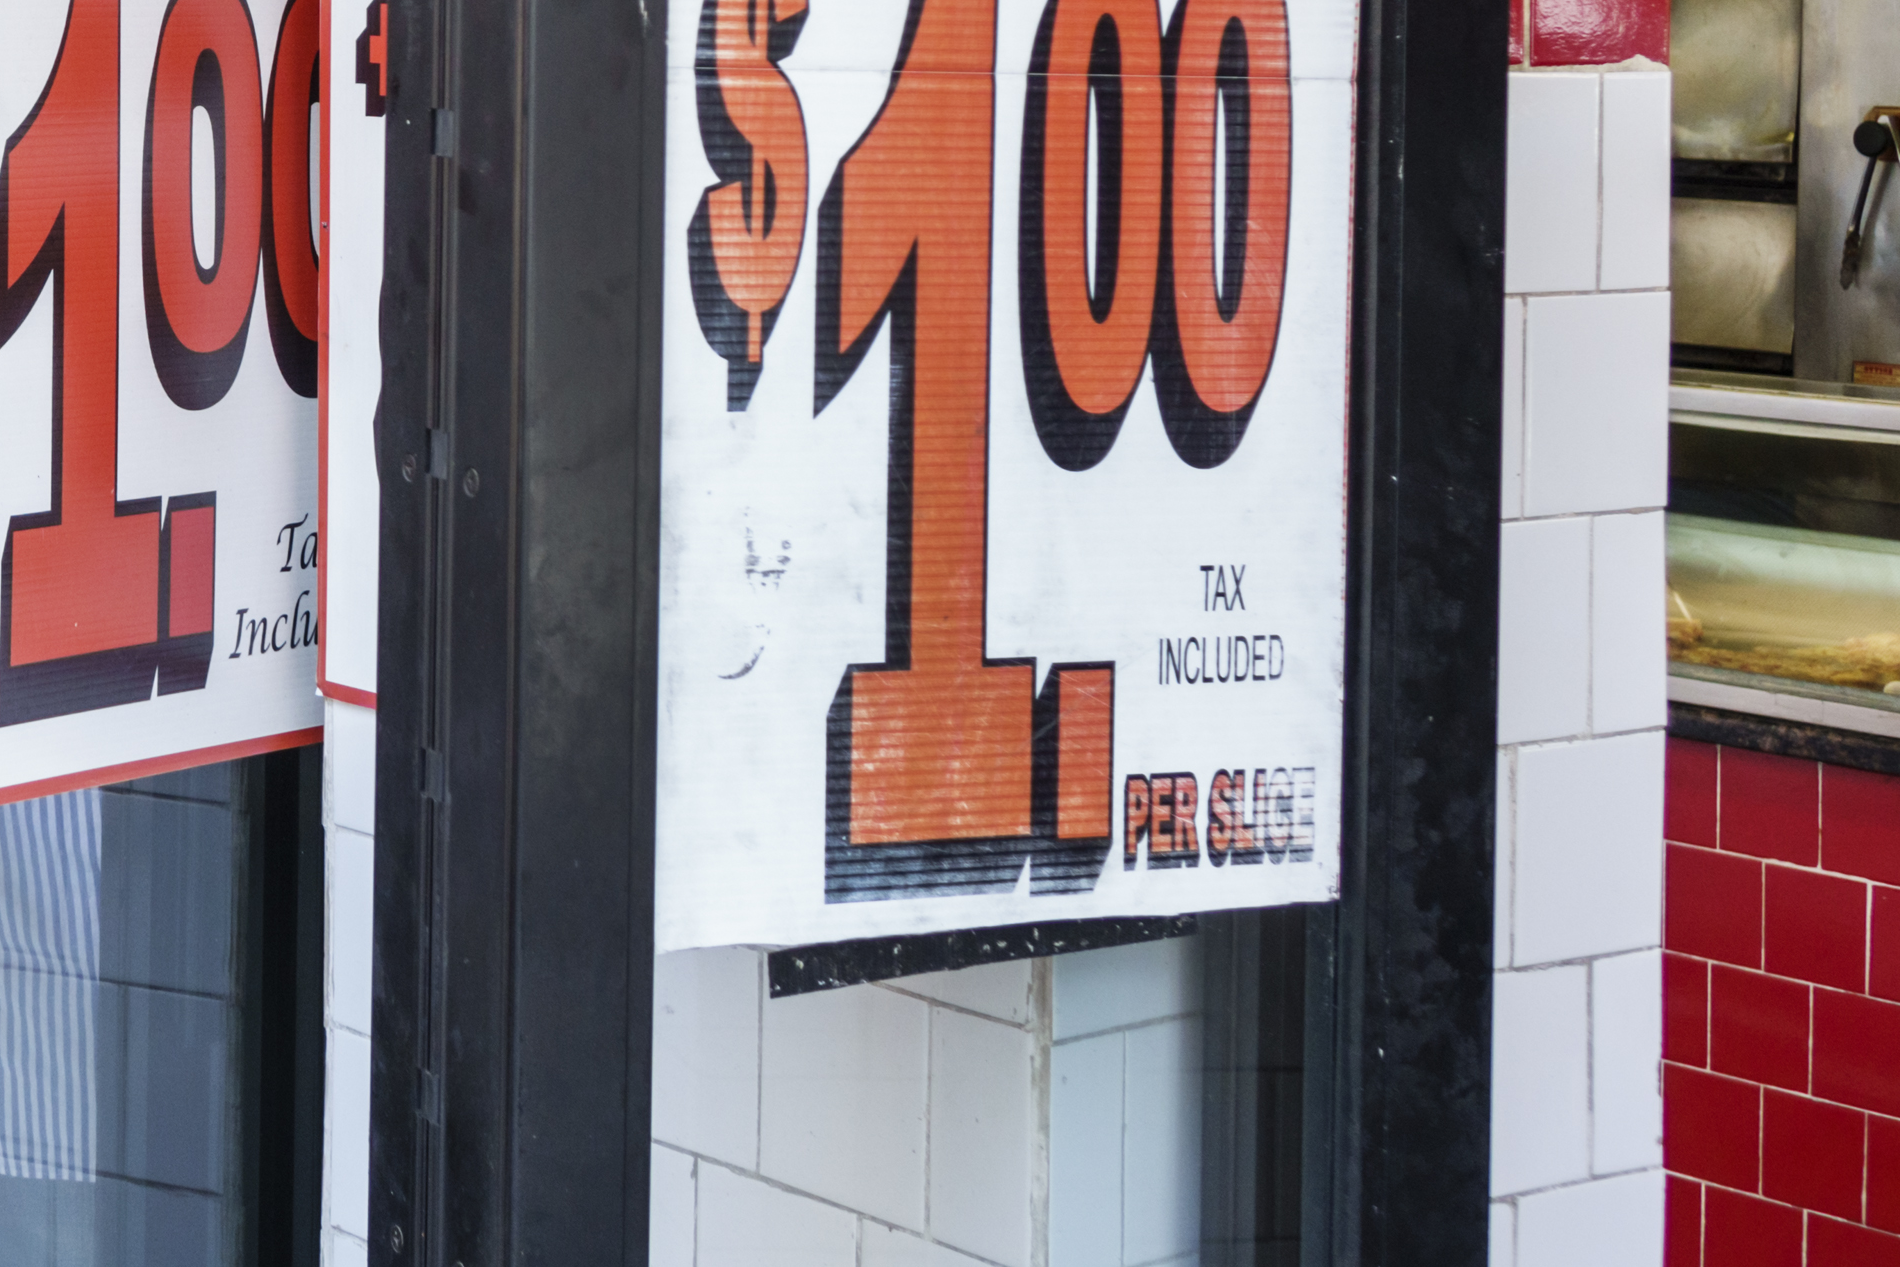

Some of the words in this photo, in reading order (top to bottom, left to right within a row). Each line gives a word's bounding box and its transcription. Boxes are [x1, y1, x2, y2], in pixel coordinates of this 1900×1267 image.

[1200, 564, 1245, 611] TAX
[1159, 634, 1284, 685] INCLUDED
[1123, 771, 1200, 872] PER
[1206, 767, 1315, 869] SLICE
